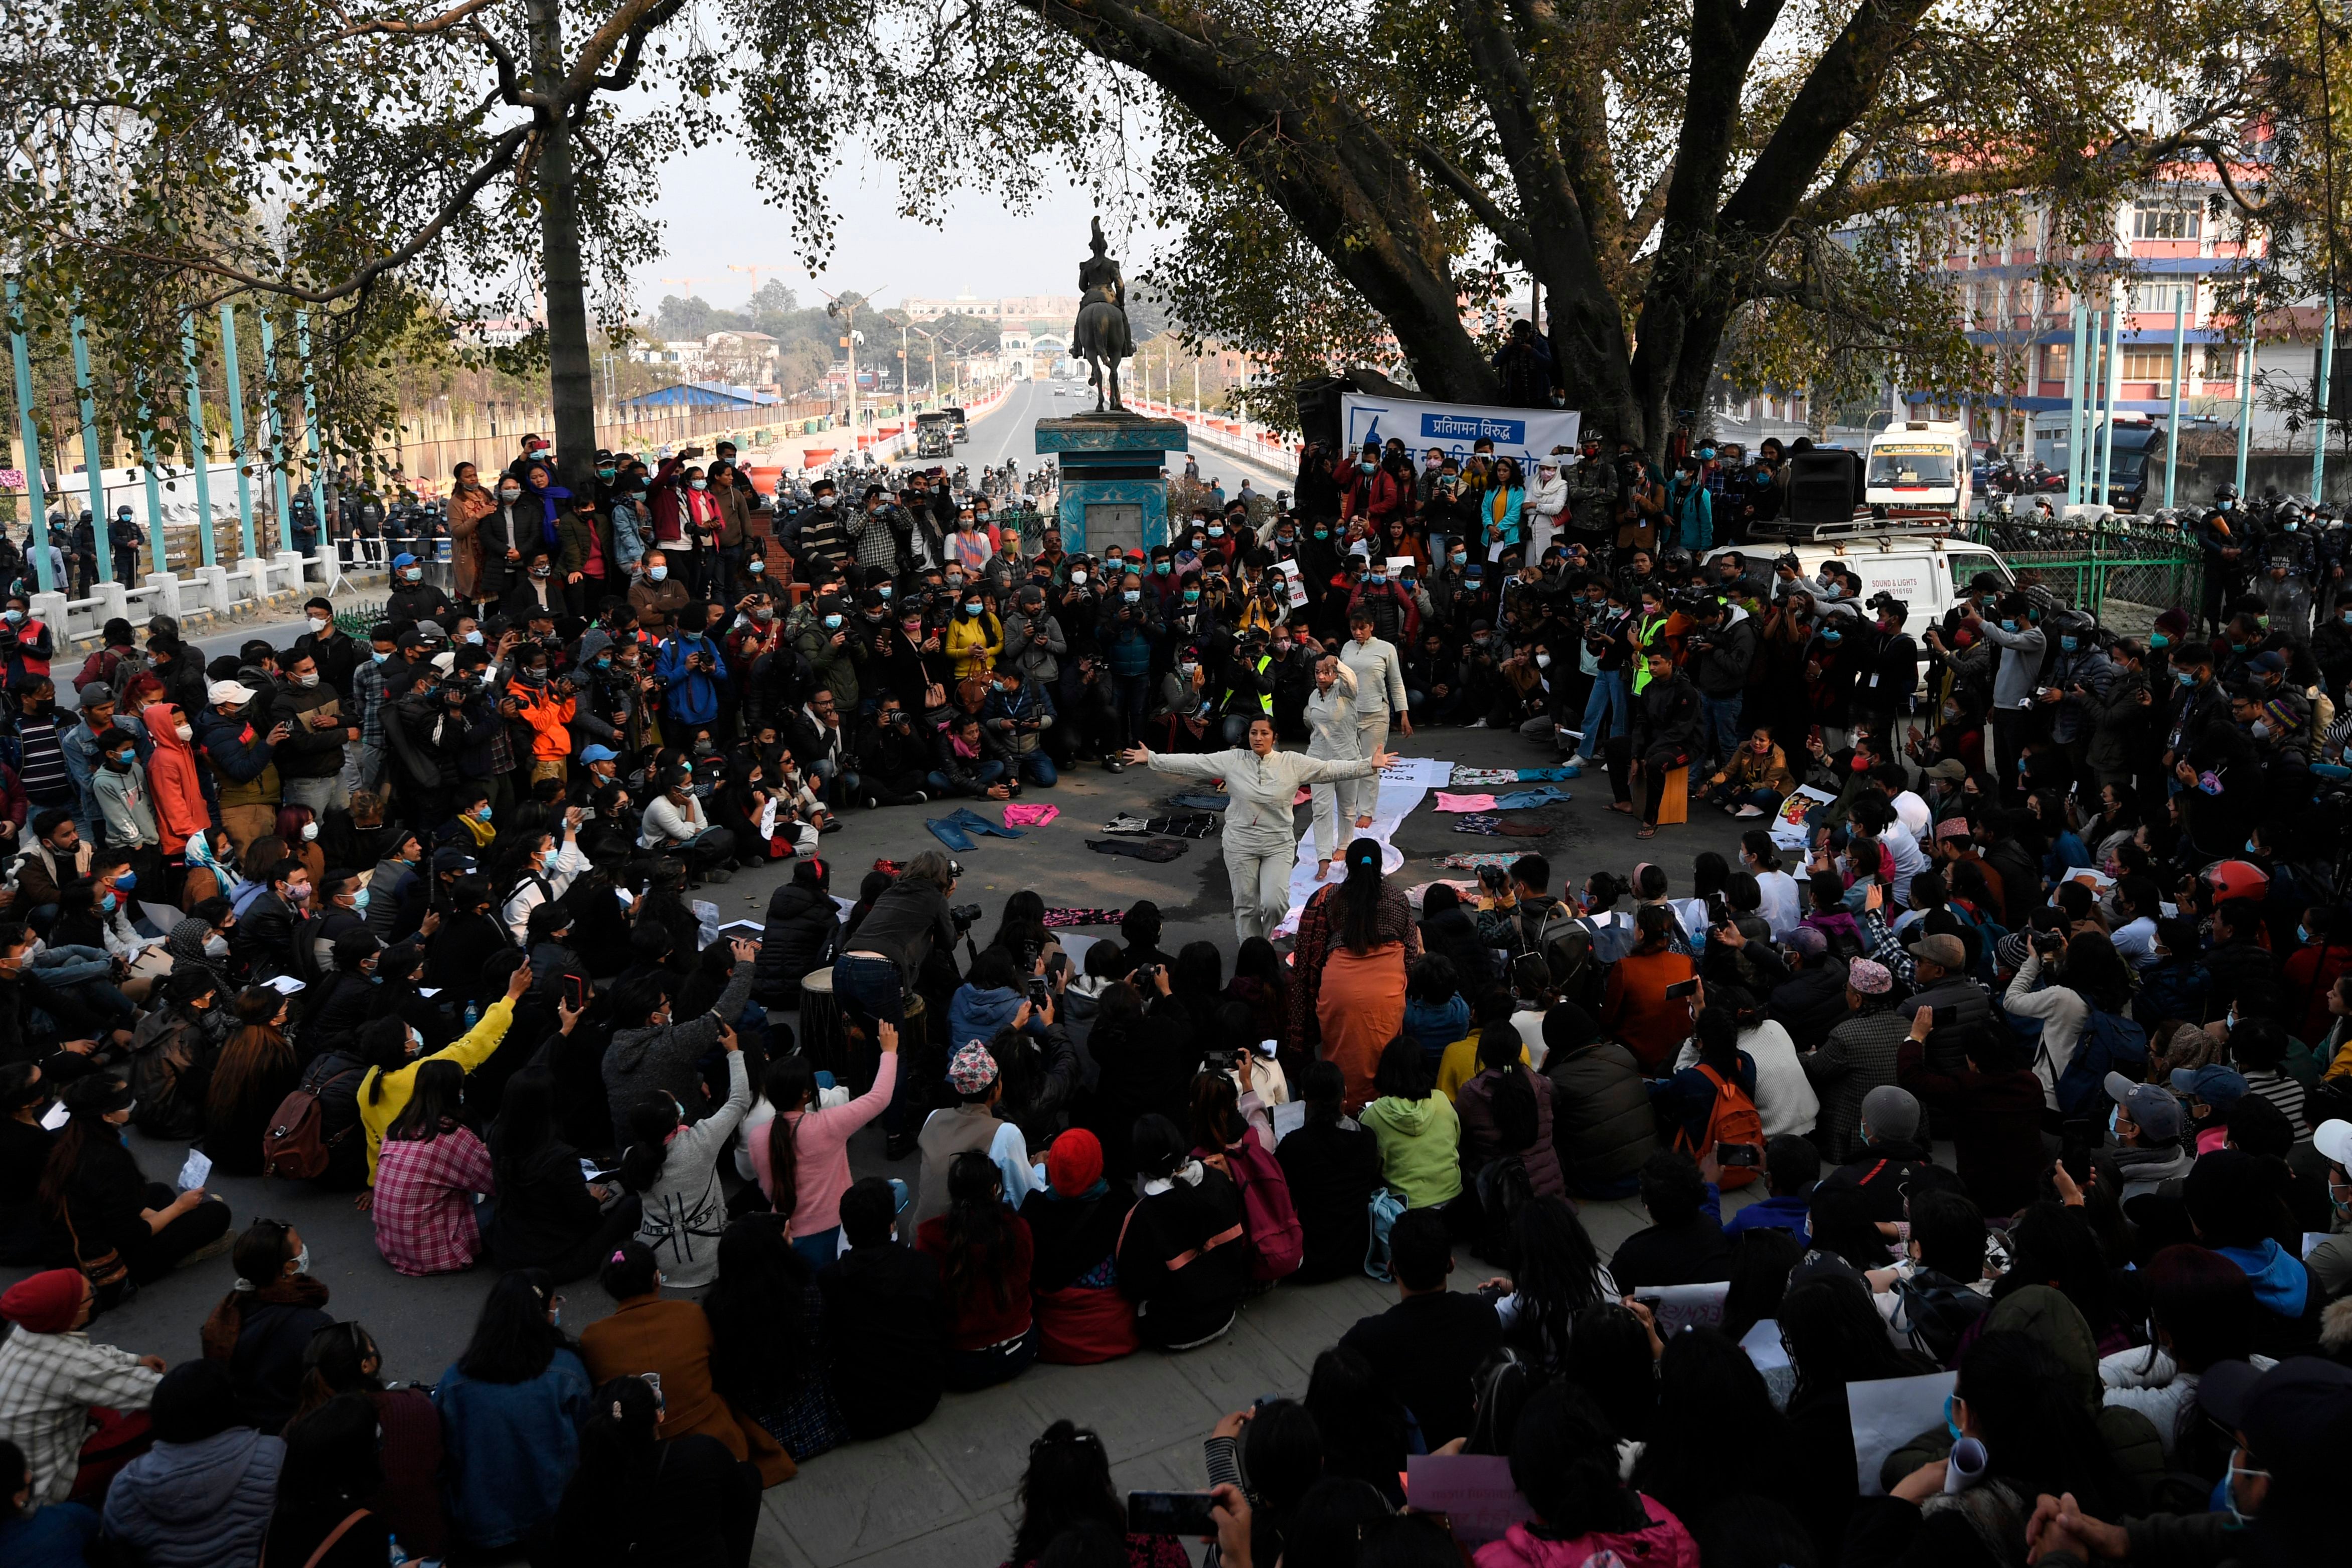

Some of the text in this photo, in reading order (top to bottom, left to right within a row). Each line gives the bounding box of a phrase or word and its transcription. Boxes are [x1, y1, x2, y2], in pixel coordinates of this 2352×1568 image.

[1433, 416, 1511, 440] प्रतिगमन विरुद्ध
[1872, 579, 1891, 587] SOUND
[1897, 578, 1917, 586] LIGHTS
[2270, 615, 2292, 623] EPAL
